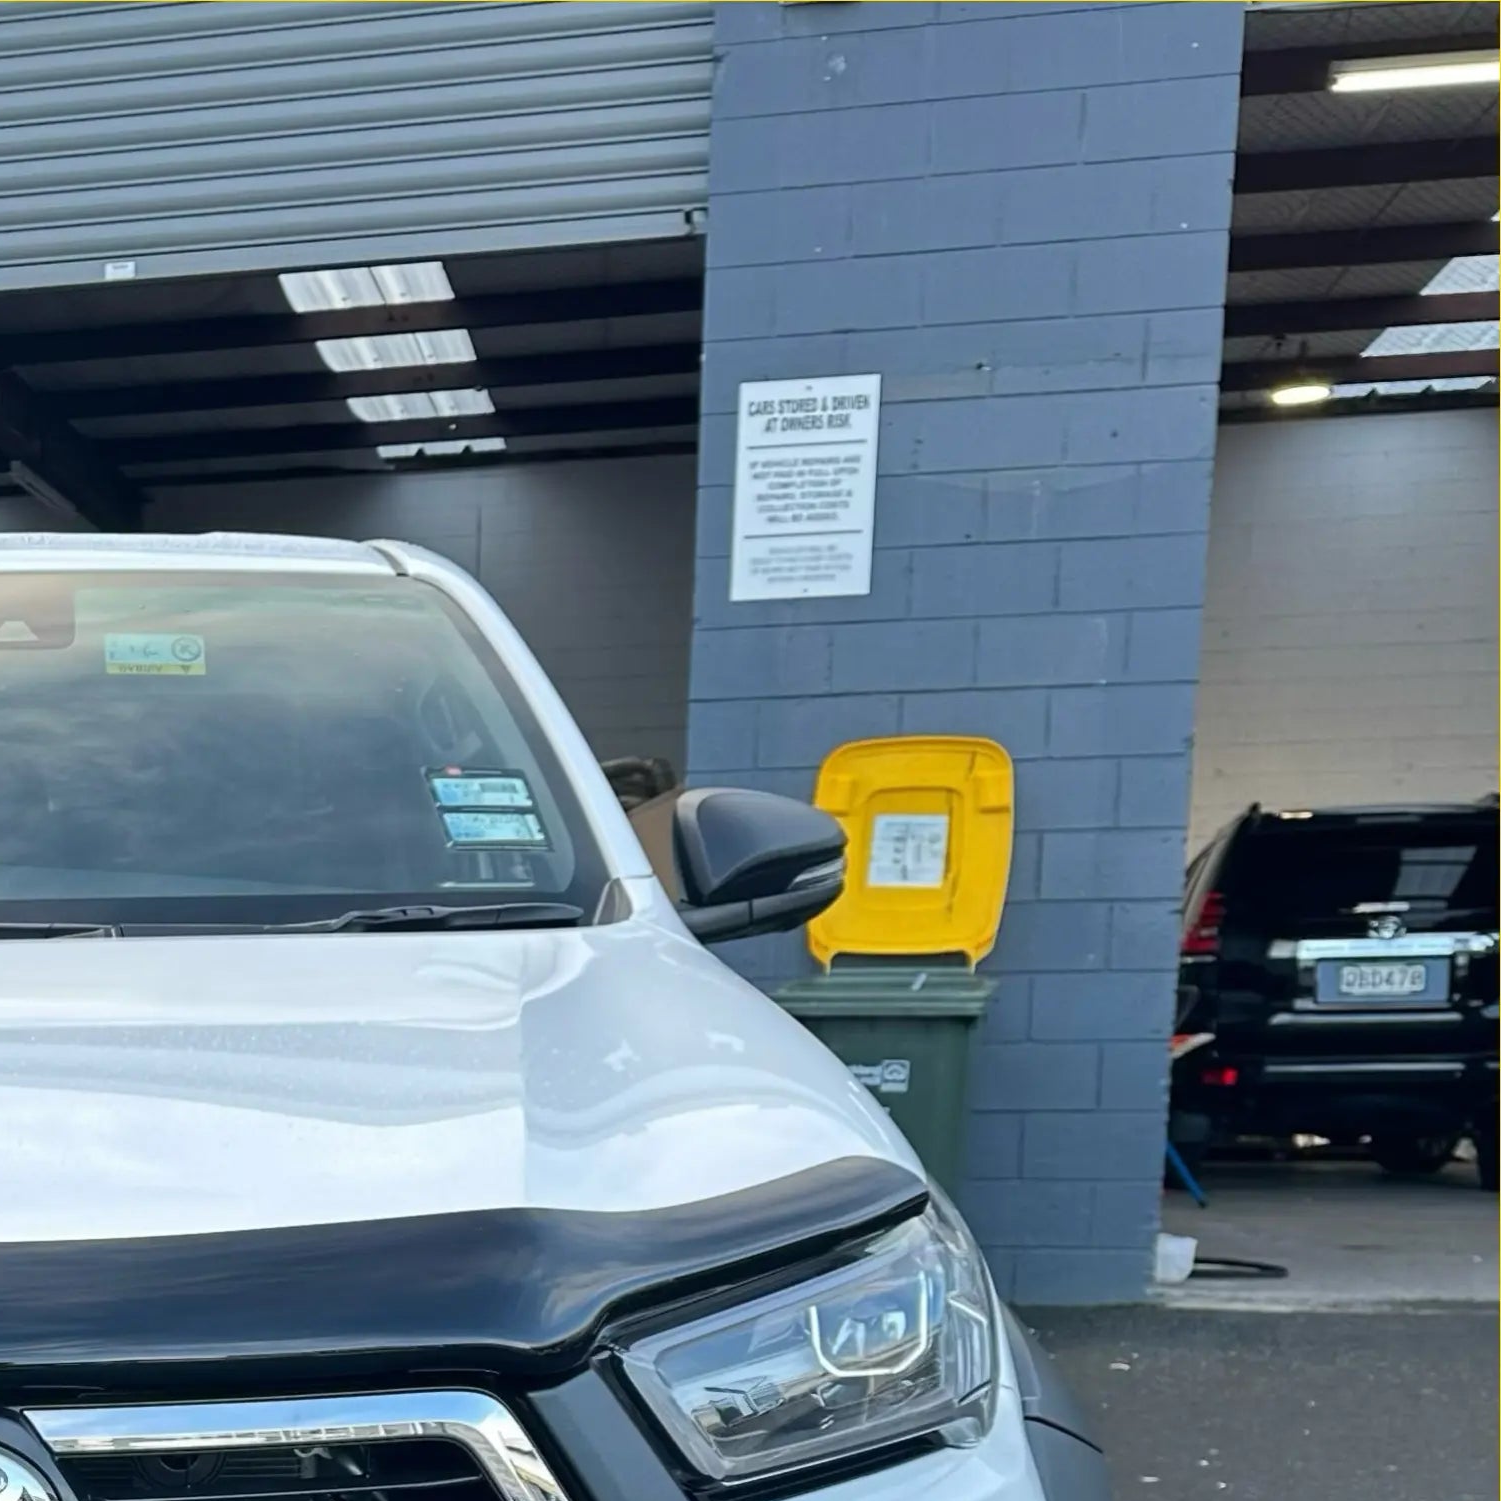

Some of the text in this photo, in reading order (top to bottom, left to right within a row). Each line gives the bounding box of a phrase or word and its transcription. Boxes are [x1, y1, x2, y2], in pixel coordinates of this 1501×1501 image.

[748, 400, 775, 416] CARS
[778, 397, 818, 414] STORED
[832, 394, 870, 411] DRIVEN
[764, 416, 778, 432] AT
[780, 415, 824, 431] OWNERS
